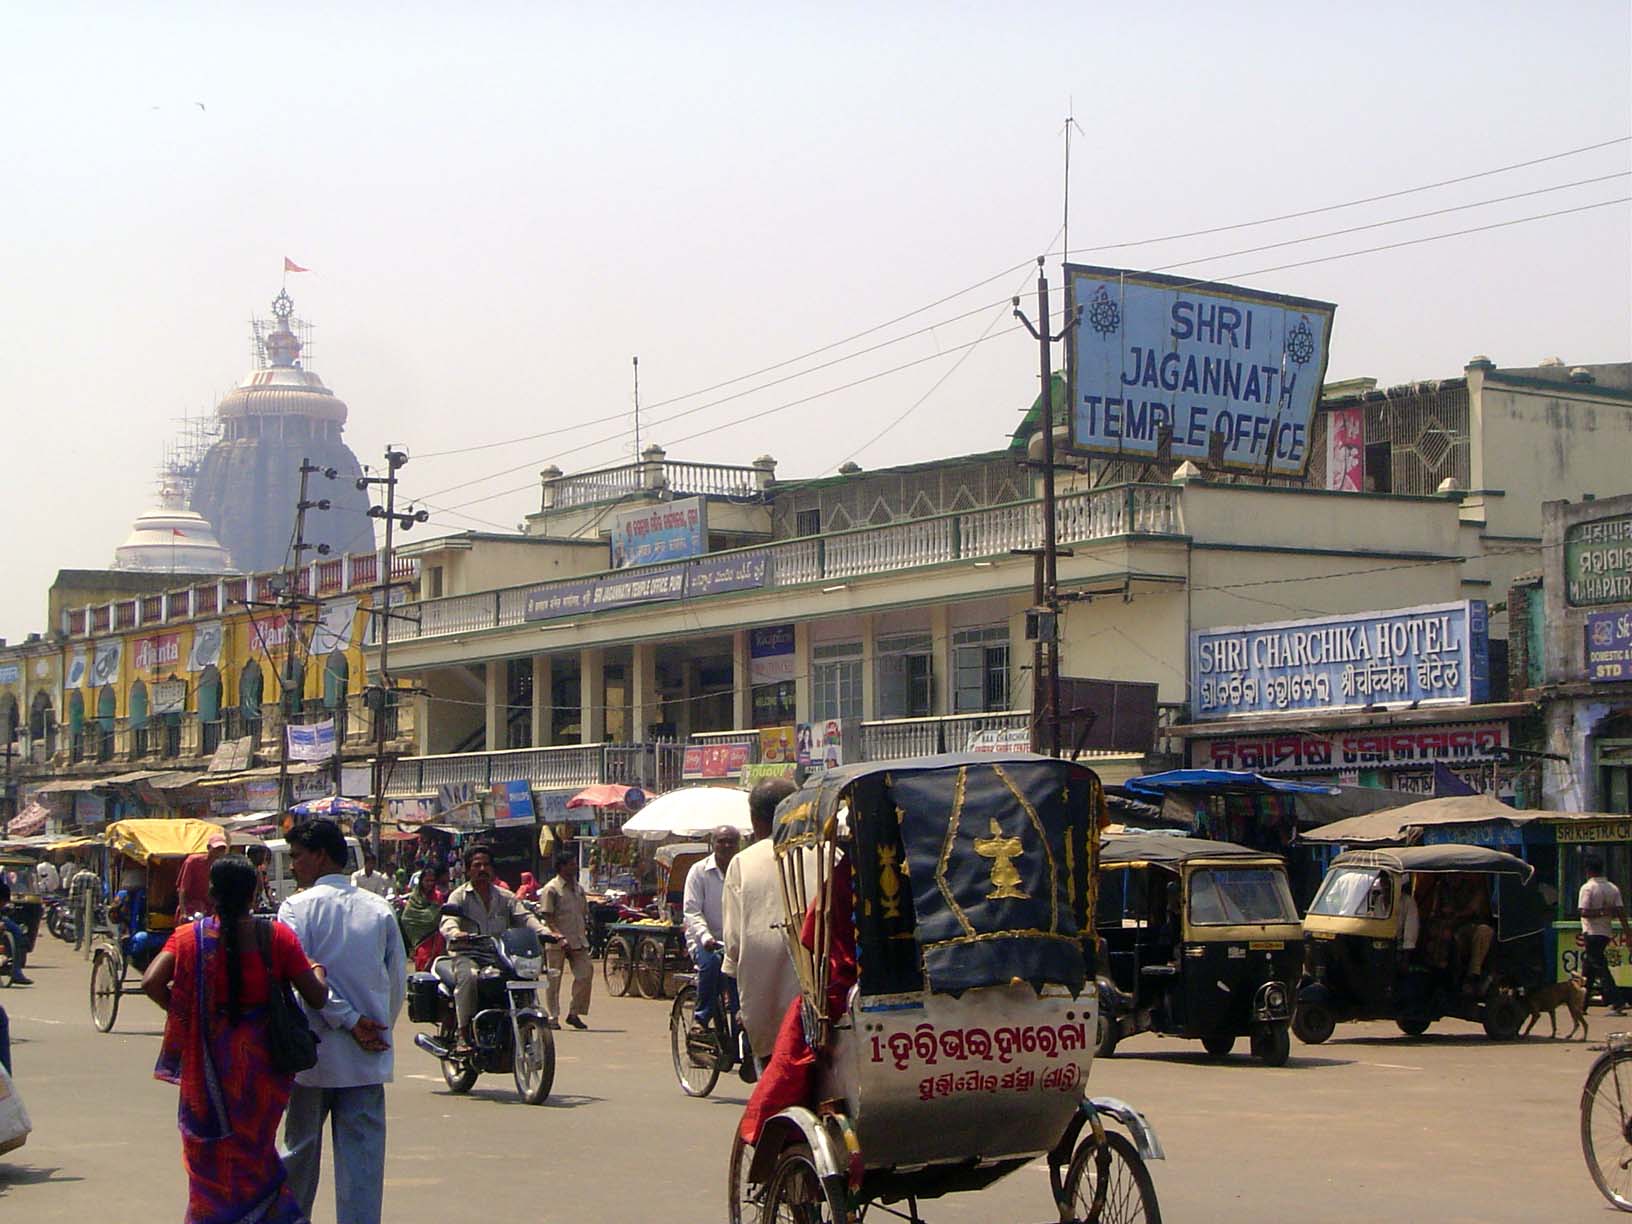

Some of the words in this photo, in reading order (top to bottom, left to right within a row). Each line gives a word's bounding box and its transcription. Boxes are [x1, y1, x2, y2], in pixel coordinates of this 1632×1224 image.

[1171, 300, 1252, 349] SHRI
[1122, 346, 1297, 409] JAGANNATH
[1084, 395, 1209, 447] TEMPLE
[1214, 409, 1305, 461] OFFICE
[1200, 637, 1249, 673] SHRI
[1254, 626, 1372, 669] CHARCHIKA
[1375, 616, 1459, 659] HOTEL
[1595, 664, 1622, 678] STD
